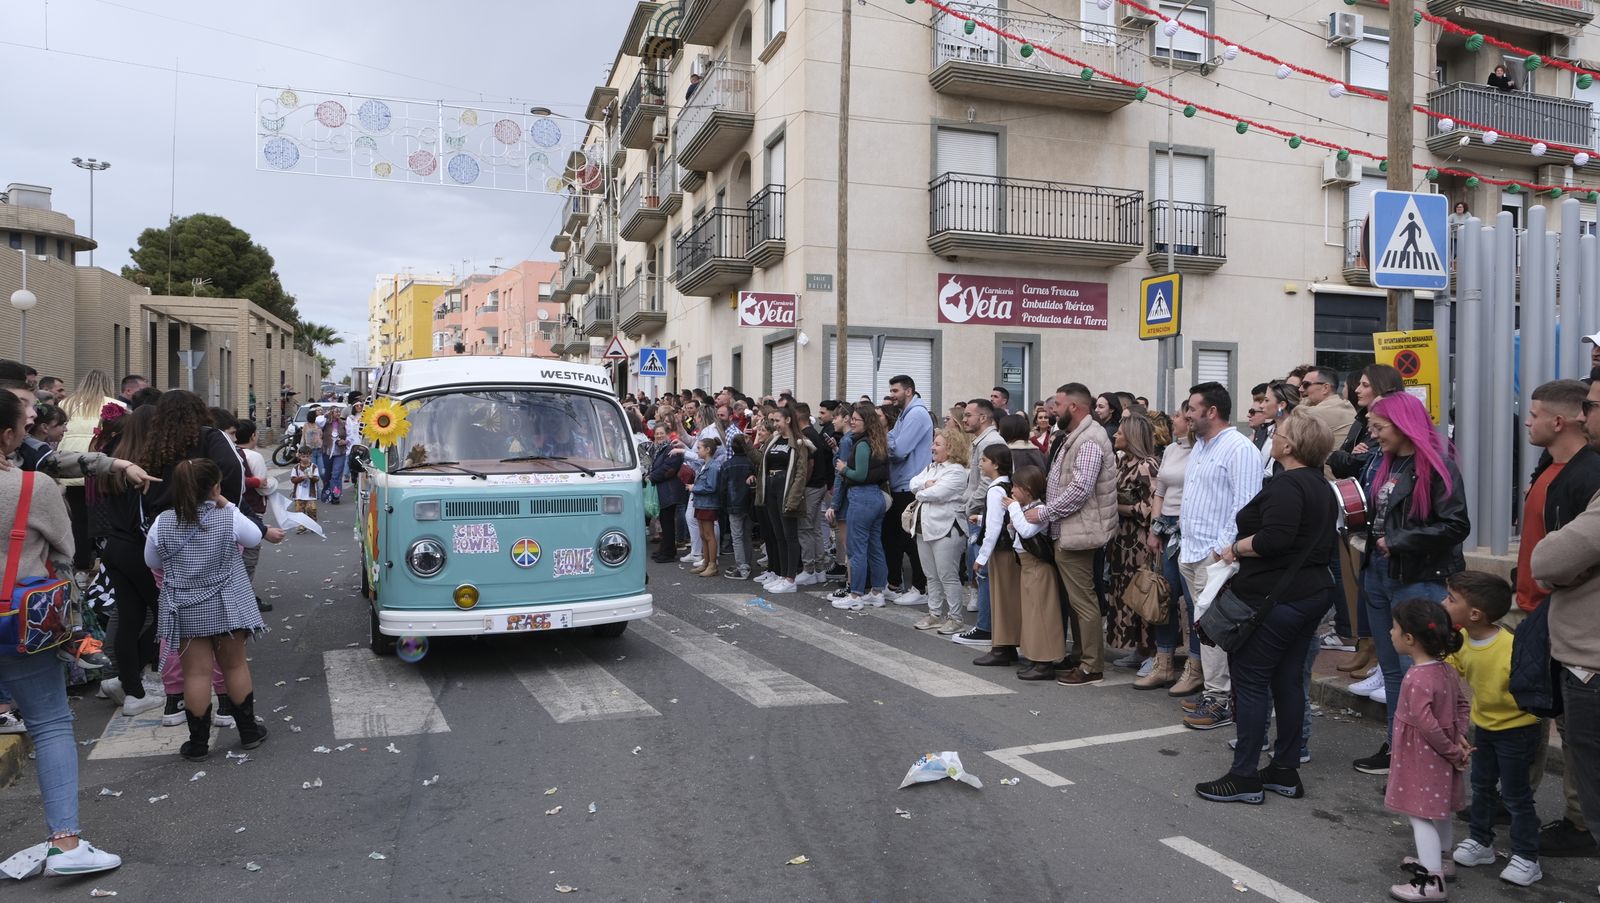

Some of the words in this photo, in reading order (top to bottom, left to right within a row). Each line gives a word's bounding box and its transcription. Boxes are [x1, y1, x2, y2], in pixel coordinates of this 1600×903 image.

[1022, 284, 1049, 295] Carnes
[1051, 286, 1080, 297] Frescas
[963, 286, 1012, 320] Yeta
[1022, 298, 1063, 310] Embutidos
[1064, 300, 1094, 312] Ibéricos
[757, 300, 794, 323] Yeta
[1021, 312, 1062, 324] Productos
[1062, 316, 1072, 324] de
[1073, 316, 1082, 325] la
[1083, 316, 1107, 326] Tierra
[540, 370, 608, 386] WESTFALIA
[456, 524, 495, 537] GIRL
[453, 538, 498, 550] POWER
[556, 548, 592, 574] LOVE
[506, 613, 551, 630] PEACE
